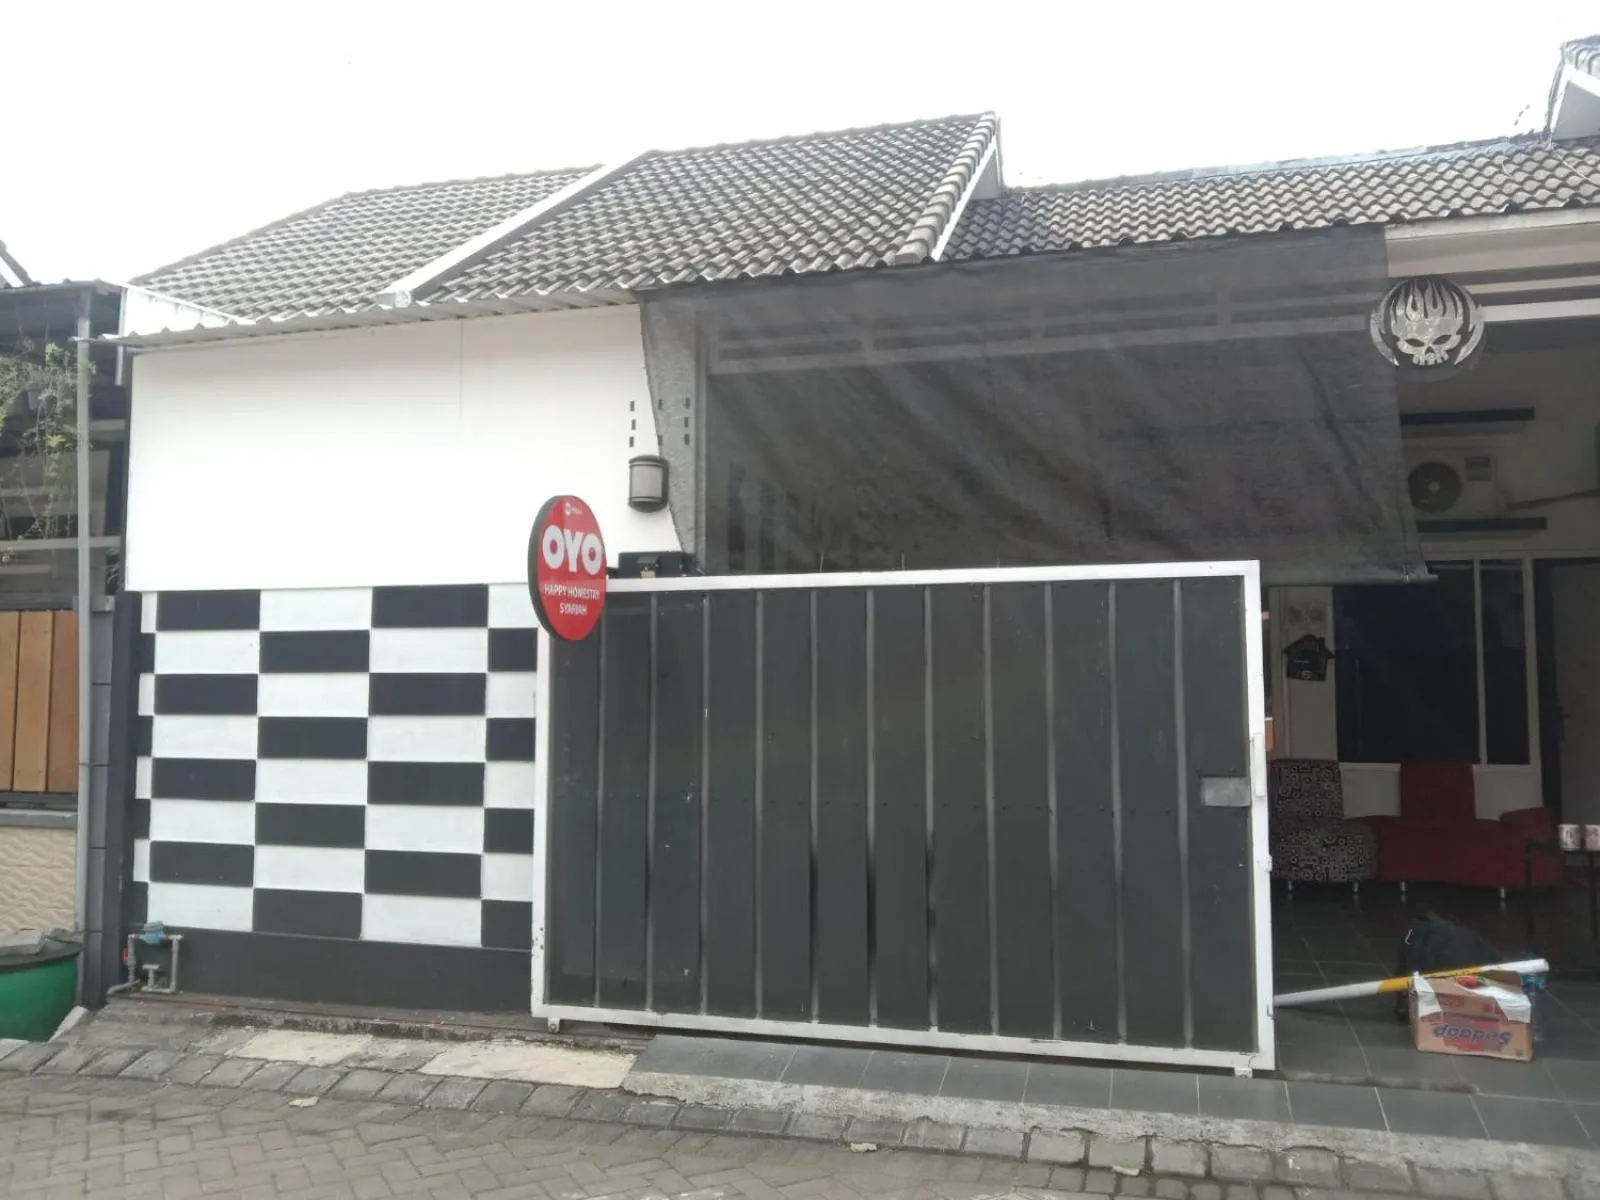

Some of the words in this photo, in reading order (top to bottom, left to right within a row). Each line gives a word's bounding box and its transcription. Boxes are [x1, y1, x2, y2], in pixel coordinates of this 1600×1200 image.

[542, 525, 603, 575] OYO
[544, 583, 567, 597] HAPPY
[568, 586, 600, 601] HOMESTAY
